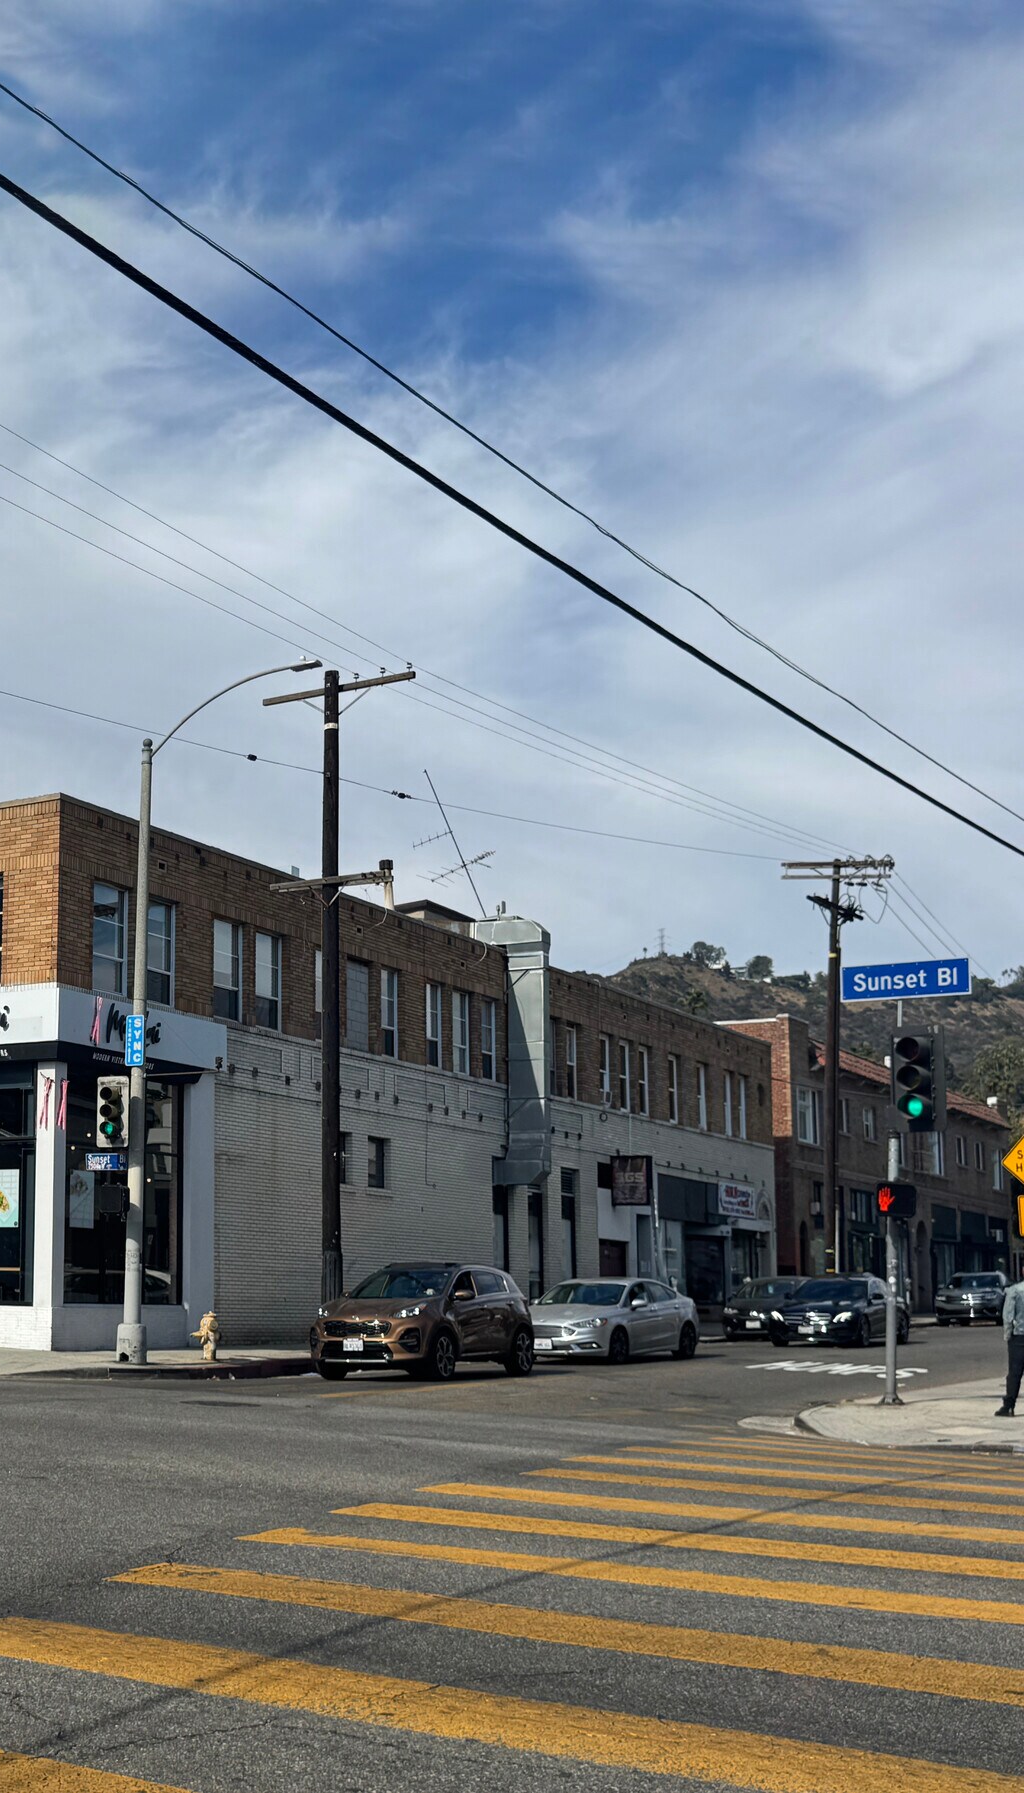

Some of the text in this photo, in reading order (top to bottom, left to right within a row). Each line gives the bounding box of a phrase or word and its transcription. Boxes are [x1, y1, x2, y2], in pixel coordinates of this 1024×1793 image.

[853, 966, 958, 993] Sunset Bl
[132, 1018, 142, 1063] SYNC
[87, 1154, 111, 1164] Sunset
